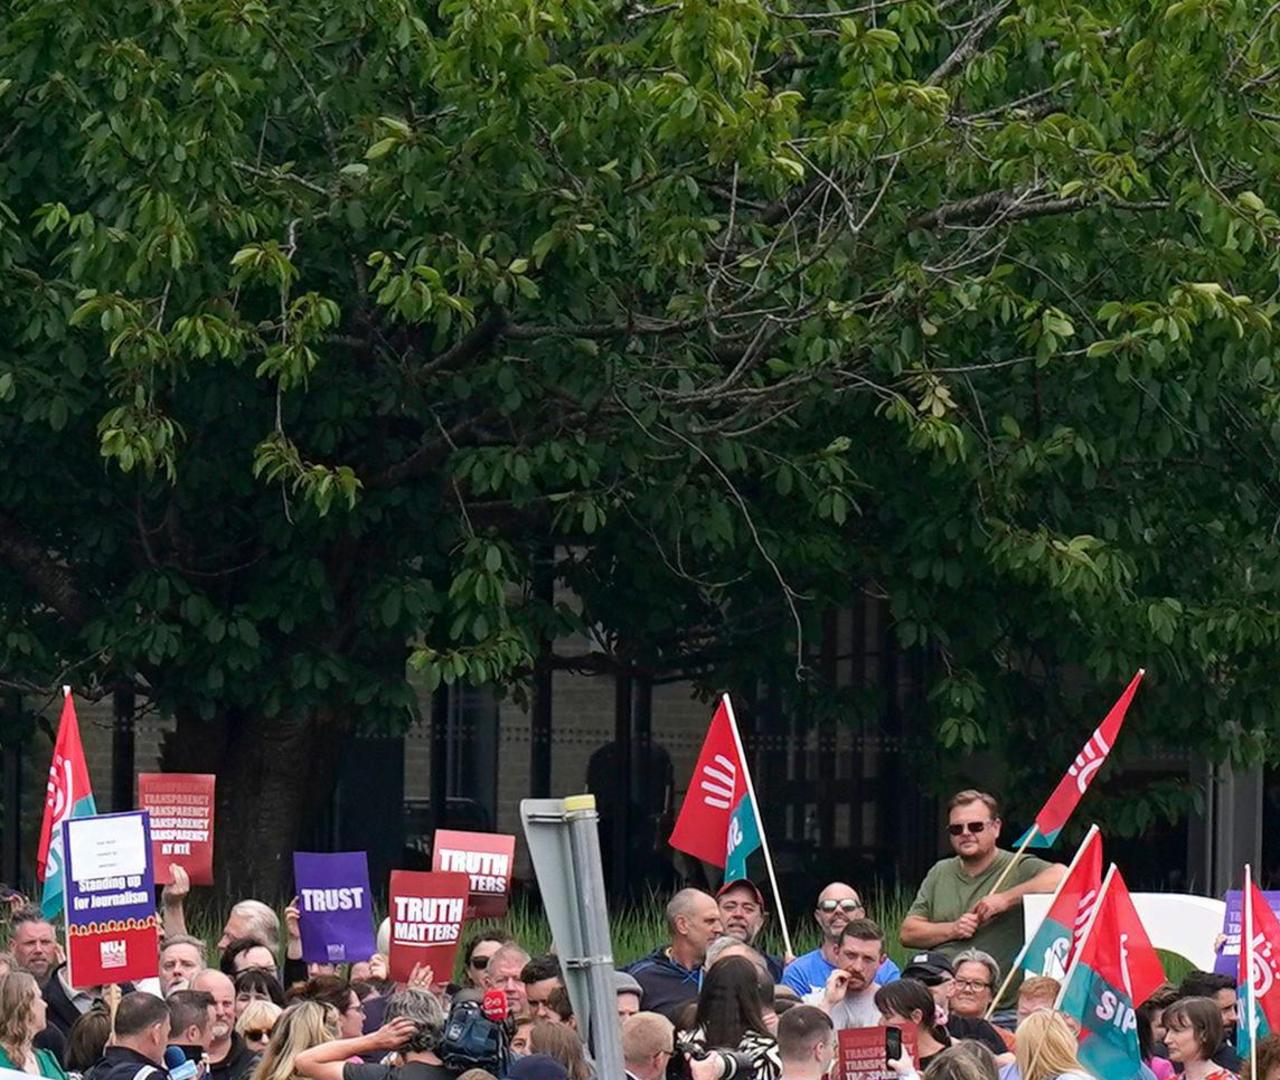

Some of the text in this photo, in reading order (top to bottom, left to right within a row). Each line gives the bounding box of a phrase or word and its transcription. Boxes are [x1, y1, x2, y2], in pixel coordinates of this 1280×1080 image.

[439, 849, 510, 875] TRUTH
[79, 876, 125, 893] Standing
[74, 891, 148, 911] for Journalism
[301, 887, 364, 912] TRUST
[394, 897, 464, 923] TRUTH
[394, 922, 461, 941] MATTERS
